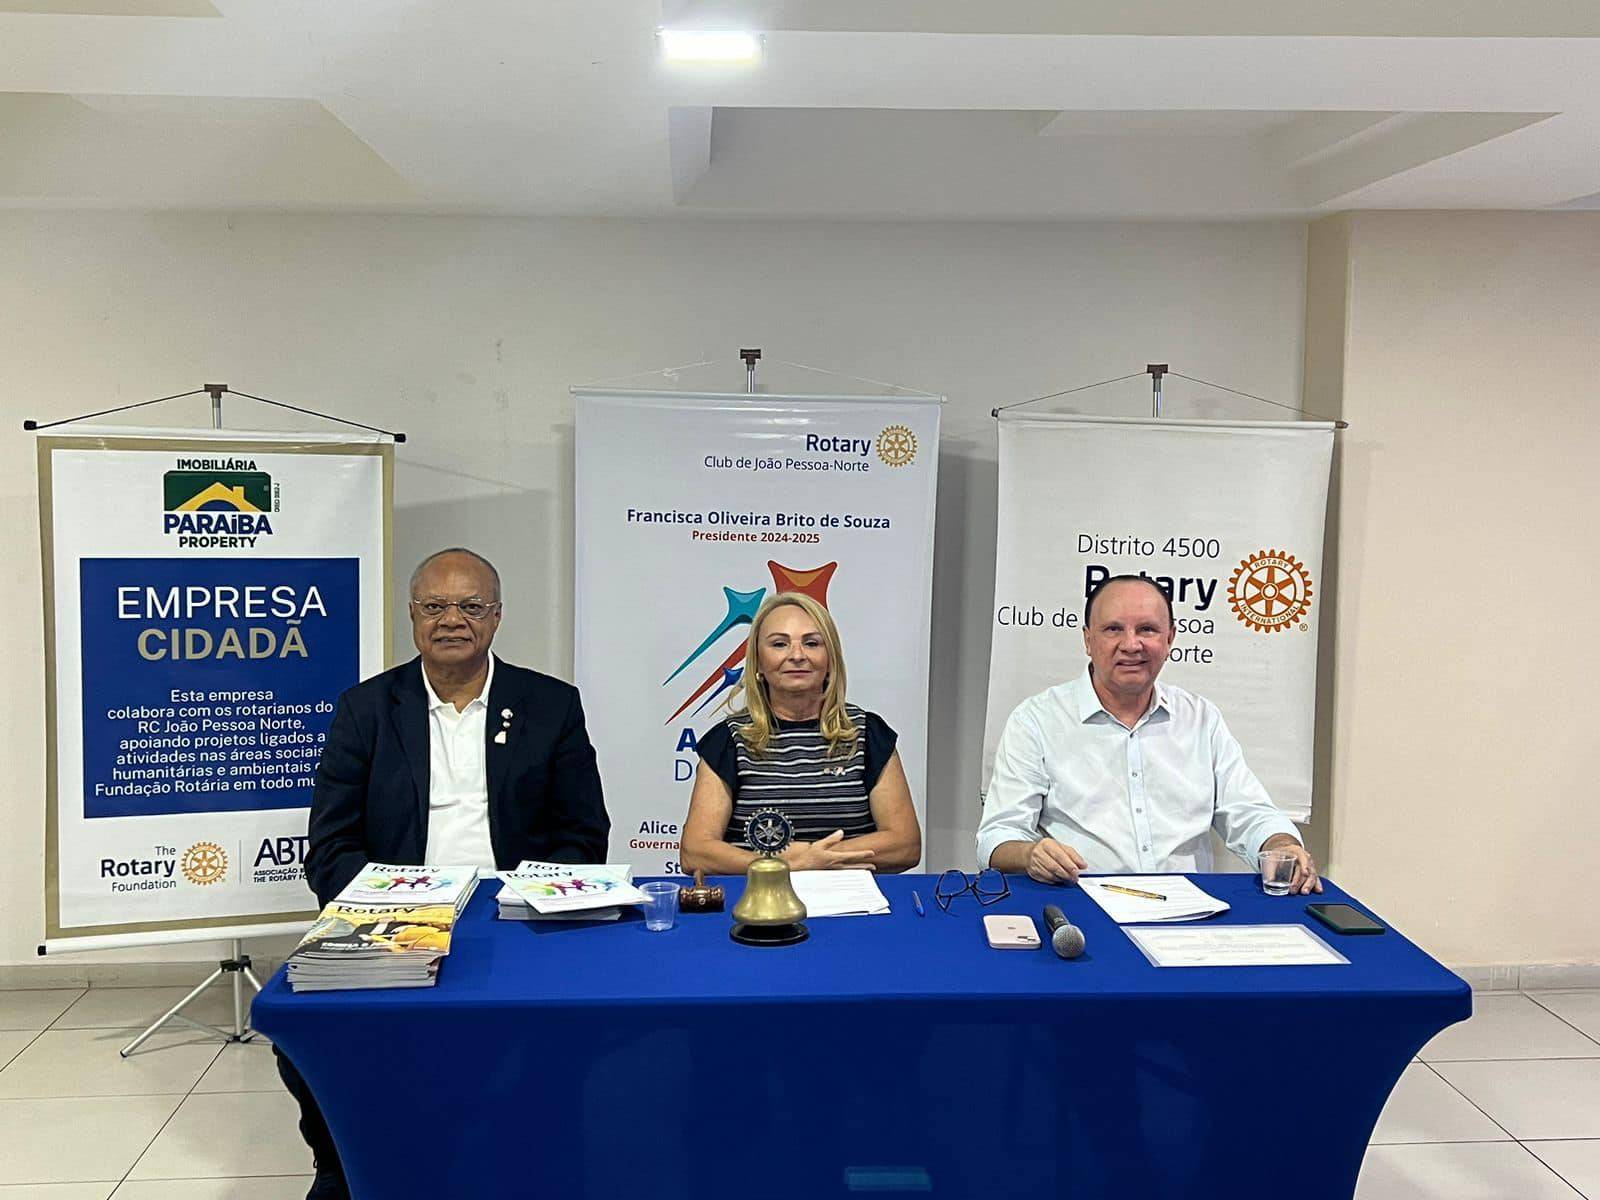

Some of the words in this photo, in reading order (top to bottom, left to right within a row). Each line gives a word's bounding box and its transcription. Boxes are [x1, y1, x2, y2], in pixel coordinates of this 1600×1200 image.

[806, 434, 872, 457] Rotary
[177, 458, 257, 471] IMOBILIÁRIA
[704, 456, 733, 469] Club
[736, 457, 751, 470] de
[753, 457, 782, 472] João
[785, 458, 869, 472] Pessoa-Norte
[627, 509, 702, 524] Francisca
[708, 510, 770, 526] Oliveira
[776, 513, 815, 528] Brito
[820, 513, 839, 528] de
[844, 515, 890, 529] Souza
[179, 536, 256, 548] PROPERTY
[692, 530, 757, 543] Presidente
[761, 532, 820, 544] 2024-2025
[1078, 535, 1155, 556] Distrito
[1162, 539, 1220, 558] 4500
[1254, 558, 1289, 569] ROTARY
[118, 586, 327, 619] EMPRESA
[998, 606, 1044, 627] Club
[1052, 608, 1078, 628] de
[1240, 603, 1299, 624] INTERNATIONAL
[138, 619, 308, 661] CIDADÃ
[1169, 645, 1213, 663] orte
[171, 689, 204, 702] Esta
[208, 690, 273, 704] empresa
[107, 705, 175, 720] colabora
[179, 707, 211, 717] com
[214, 706, 232, 716] os
[235, 703, 312, 716] rotarianos
[315, 700, 334, 713] do
[138, 720, 160, 733] RC
[164, 720, 198, 733] João
[202, 719, 256, 732] Pessoa
[119, 735, 190, 751] apoiando
[194, 733, 256, 749] projetos
[260, 731, 314, 747] ligados
[317, 732, 326, 742] a
[116, 750, 196, 765] atividades
[199, 750, 226, 762] nas
[230, 748, 272, 761] áreas
[112, 765, 213, 781] humanitárias
[216, 766, 226, 776] e
[230, 760, 311, 776] ambientais
[675, 759, 693, 781] D
[95, 780, 171, 798] Fundação
[175, 778, 229, 793] Rotária
[233, 779, 256, 790] em
[260, 775, 293, 789] todo
[639, 821, 677, 834] Alice
[155, 846, 176, 856] The
[254, 836, 309, 867] ABT
[630, 839, 680, 849] Governa
[101, 858, 176, 878] Rotary
[372, 865, 440, 873] Rotary
[665, 861, 681, 874] St
[112, 879, 177, 892] Foundation
[337, 905, 415, 915] Rotary
